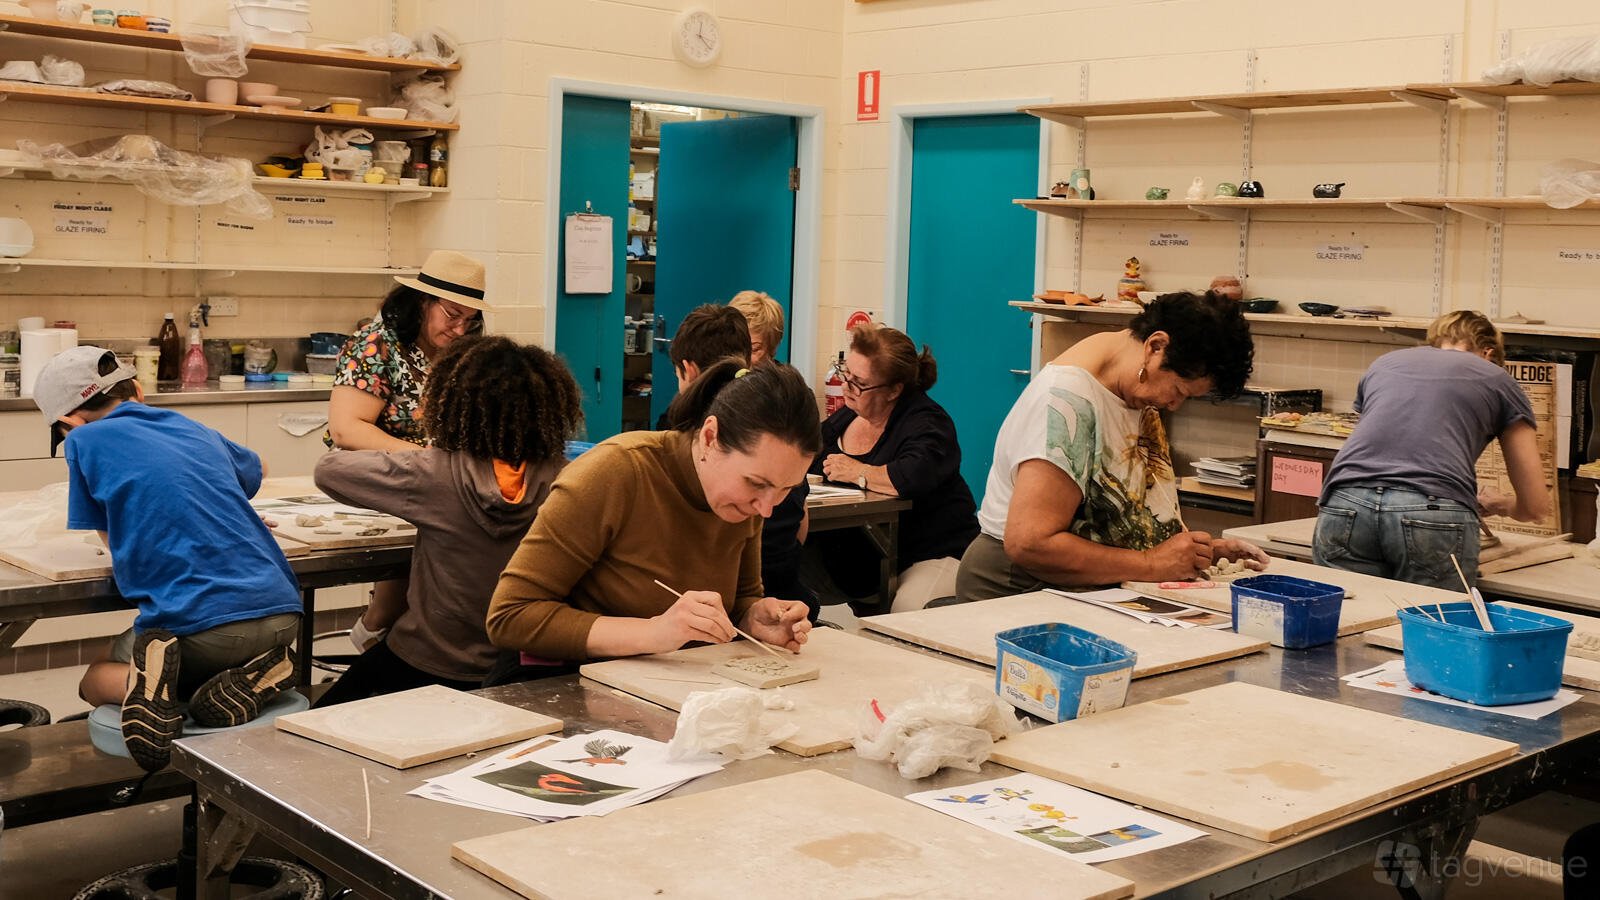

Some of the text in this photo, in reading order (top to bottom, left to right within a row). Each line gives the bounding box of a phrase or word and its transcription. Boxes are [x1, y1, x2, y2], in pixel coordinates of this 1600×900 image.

[55, 225, 106, 234] GLAZE FIRING
[1316, 252, 1362, 261] GLAZE FIRING
[1559, 251, 1581, 261] Ready
[1274, 461, 1321, 477] WEDNESDAY
[1273, 472, 1287, 485] DAY
